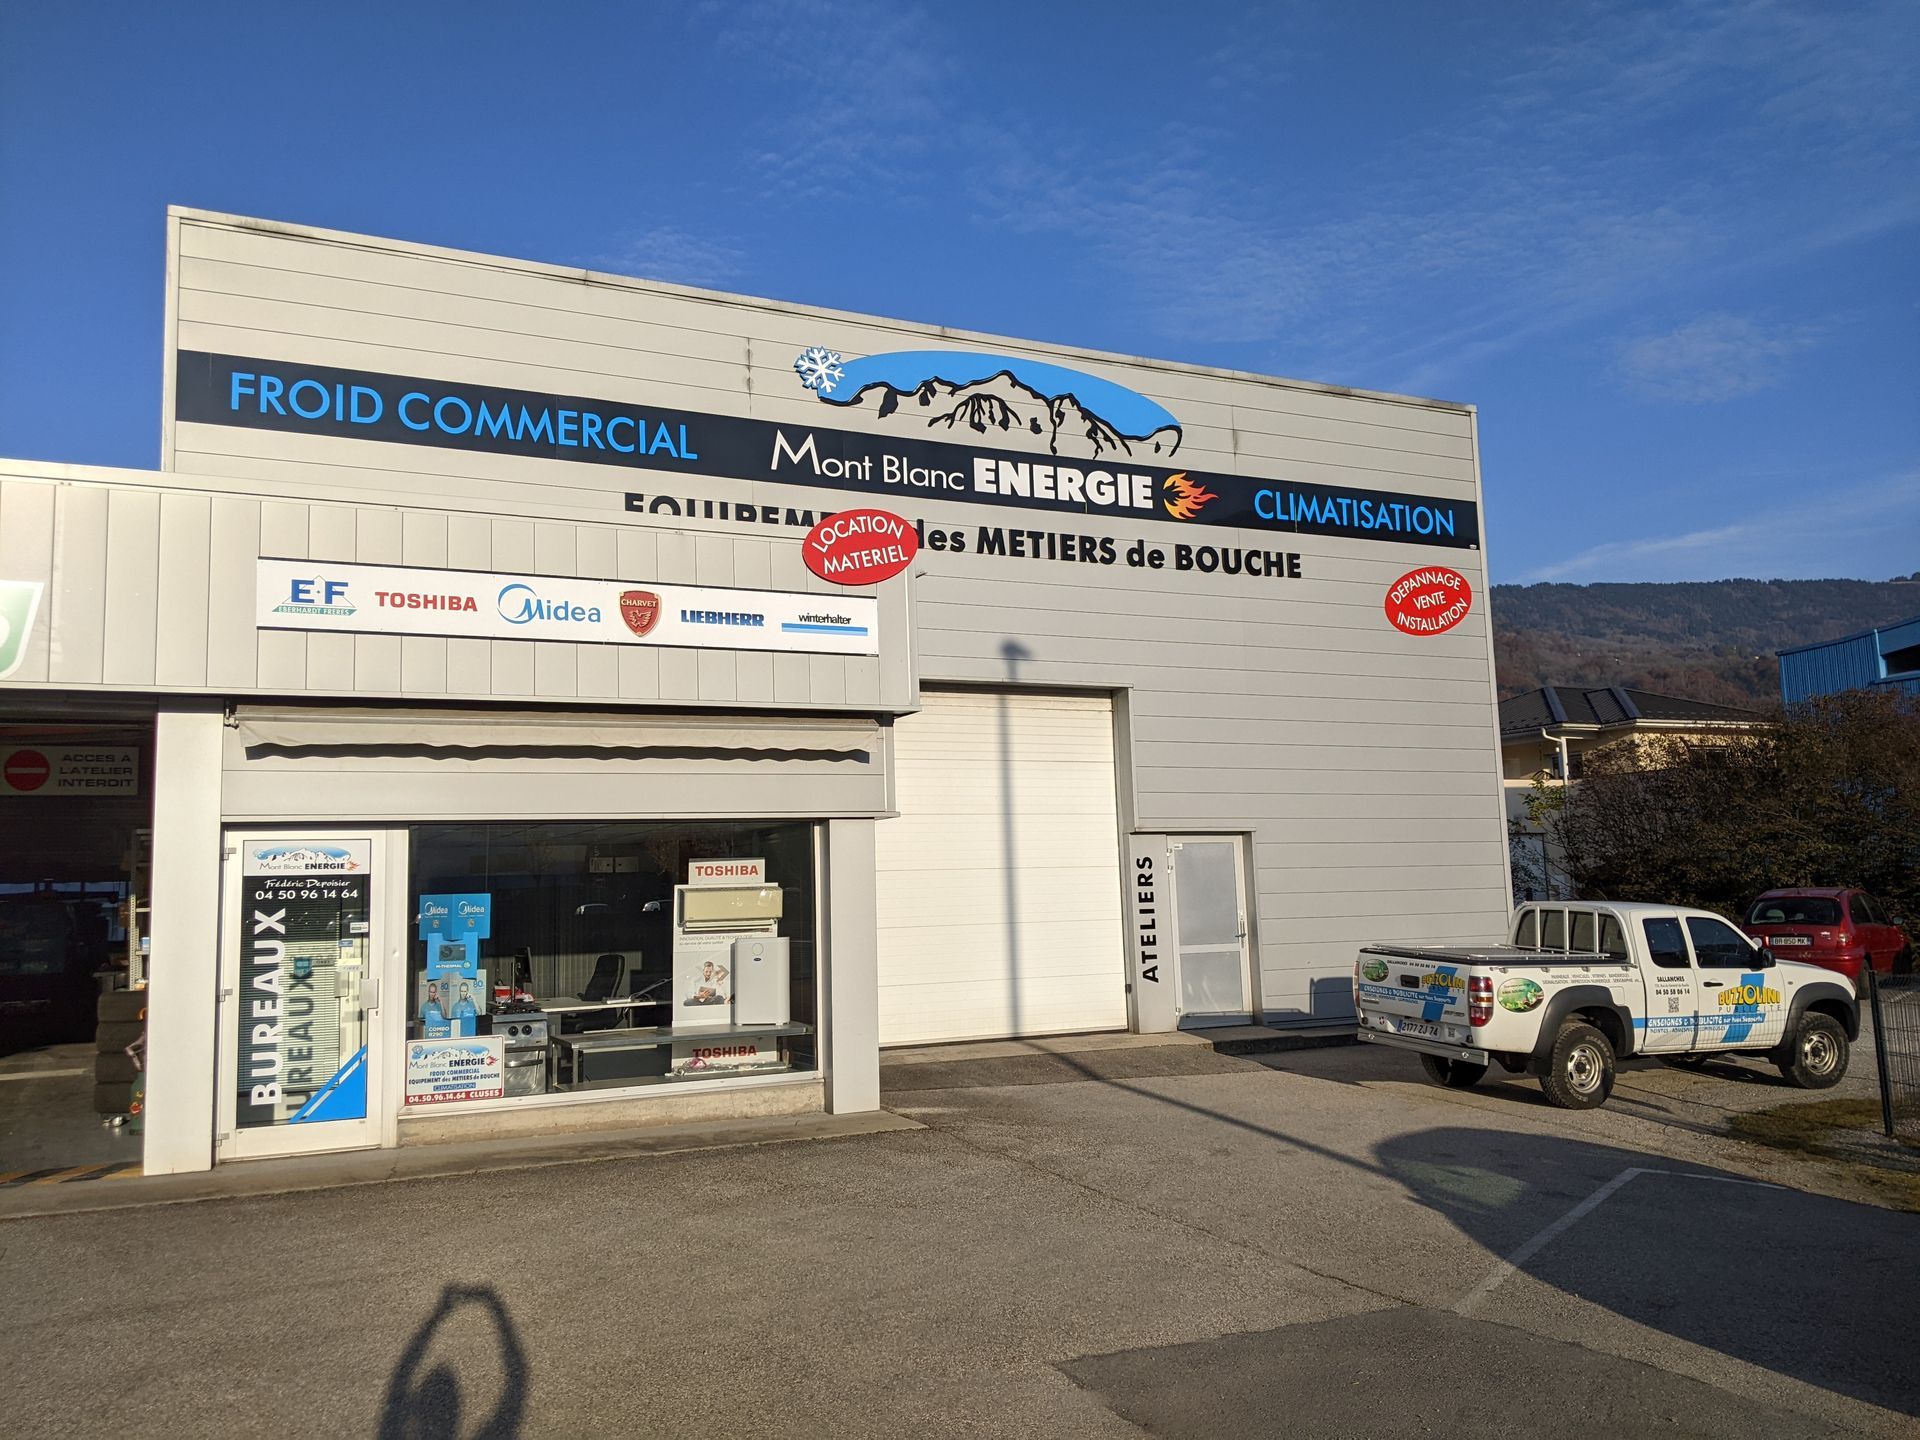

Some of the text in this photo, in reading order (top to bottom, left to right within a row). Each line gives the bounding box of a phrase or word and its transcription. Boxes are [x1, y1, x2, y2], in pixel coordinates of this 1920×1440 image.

[230, 371, 699, 461] FROID COMMERCIAL
[770, 429, 1154, 510] Mont Blanc ENERGIE
[1254, 489, 1455, 537] CLIMATISATION
[811, 514, 904, 553] LOCATION
[823, 544, 909, 575] MATERIEL
[977, 525, 1117, 566] METIERS
[1126, 538, 1165, 570] de
[1174, 543, 1302, 579] BOUCHE
[1390, 571, 1463, 605] DEPANNAGE
[375, 591, 478, 612] TOSHIBA
[503, 587, 601, 623] Midea
[621, 598, 657, 608] CHARVET
[1412, 591, 1447, 611] VENTE
[681, 609, 765, 627] LIEBHERR
[798, 612, 851, 625] winterhalter
[1396, 598, 1468, 632] INSTALLATION
[62, 754, 116, 762] ACCES
[58, 779, 134, 787] INTERDIT
[259, 862, 282, 870] Mont
[304, 862, 345, 870] ENERGIE
[695, 865, 759, 877] TOSHIBA
[306, 879, 350, 889] Depoisier
[255, 889, 358, 900] 04 50 96 14 64
[1136, 856, 1159, 983] ATELIERS
[1718, 984, 1782, 1006] BUZZOLINI
[251, 907, 287, 1106] BUREAUX
[1402, 1022, 1438, 1036] 2177 ZJ 74
[1648, 1018, 1682, 1026] ENSEIGNES
[692, 1045, 758, 1059] TOSHIBA
[449, 1058, 485, 1067] ENERGIE
[470, 1089, 500, 1098] CLUSES
